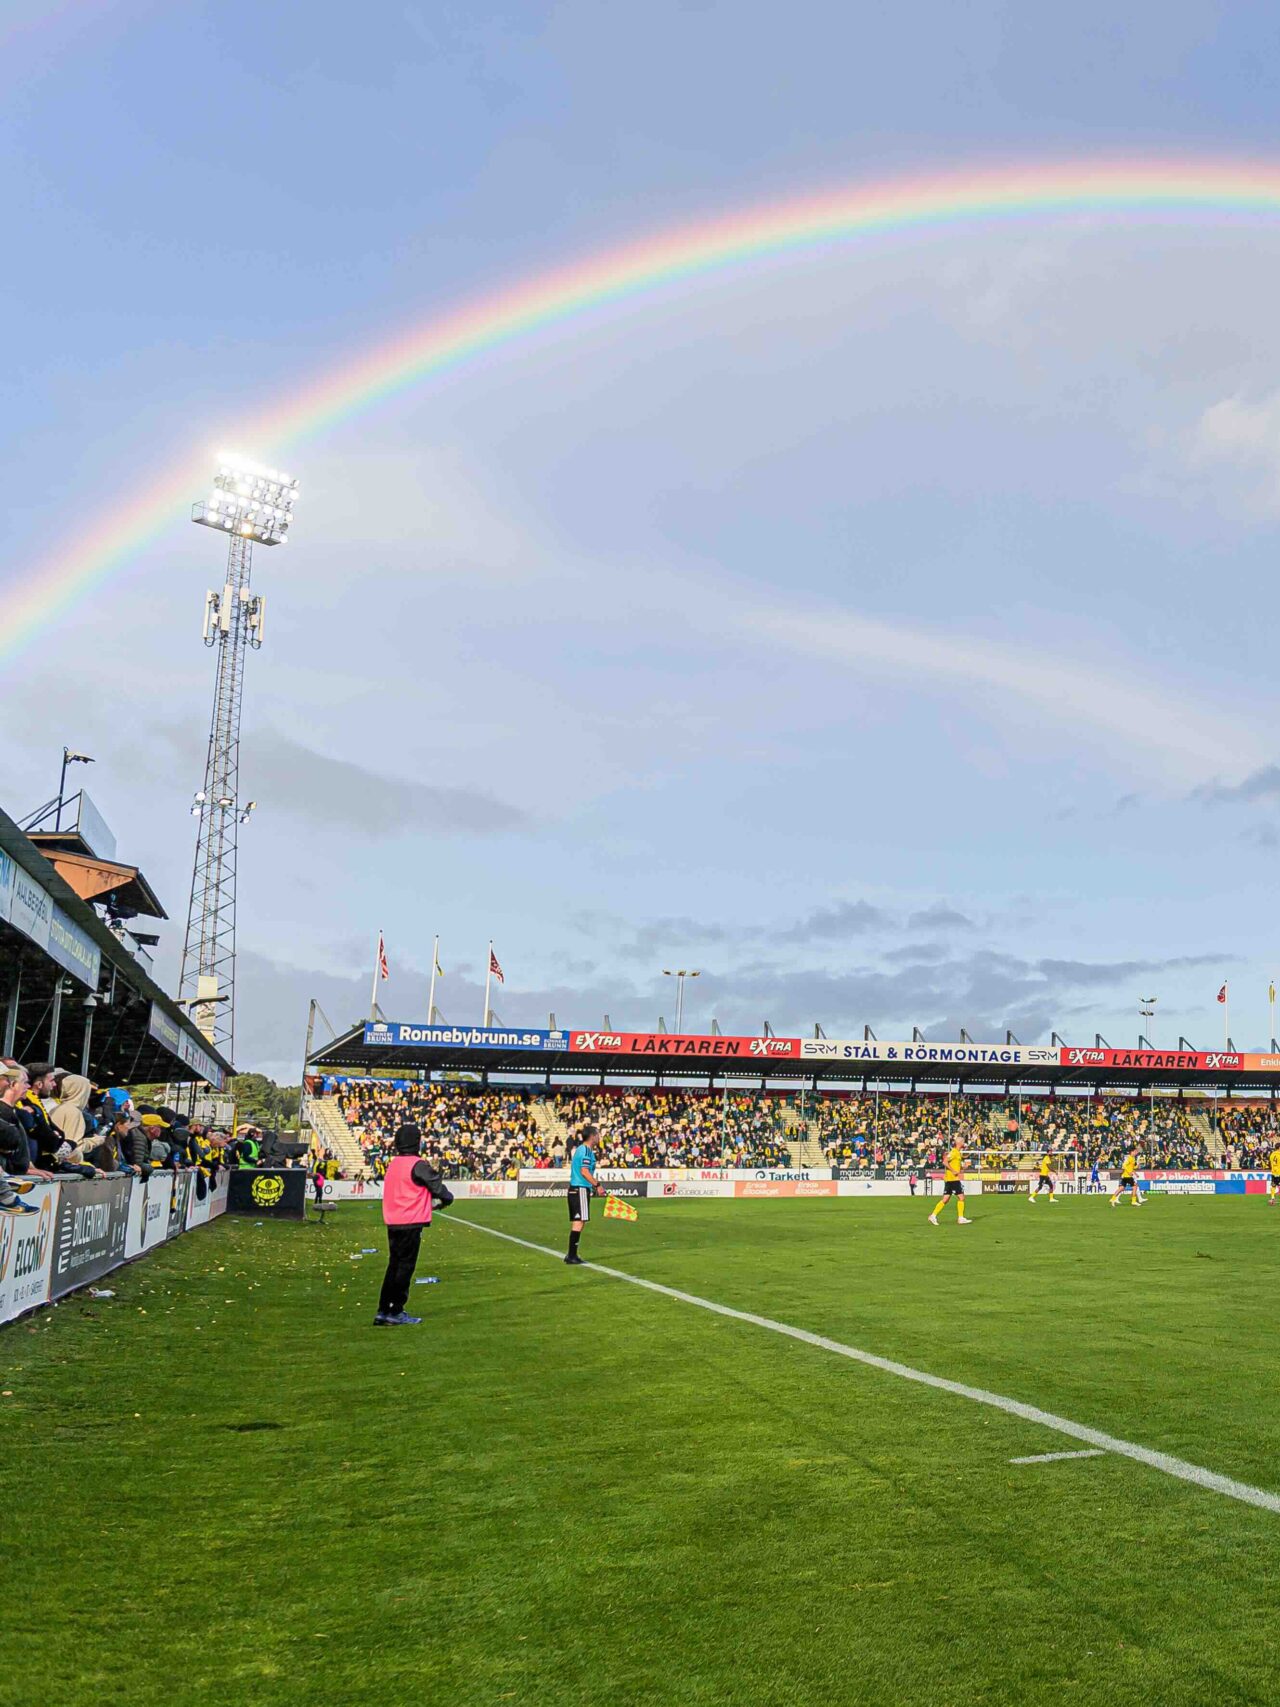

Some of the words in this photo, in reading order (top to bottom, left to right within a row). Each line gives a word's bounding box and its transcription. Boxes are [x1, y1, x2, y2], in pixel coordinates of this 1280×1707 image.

[399, 1026, 540, 1048] Ronnebybrunn.se
[631, 1036, 740, 1054] LÄKTAREN
[804, 1043, 838, 1054] SRM
[844, 1043, 880, 1059] STÅL
[887, 1047, 898, 1059] &
[904, 1045, 1021, 1062] RÖRMONTAGE
[1028, 1050, 1058, 1061] SRM
[1112, 1051, 1198, 1067] LÄKTAREN
[1274, 1155, 1279, 1164] 4
[769, 1171, 810, 1181] Tarkett
[1017, 1183, 1029, 1192] AIF
